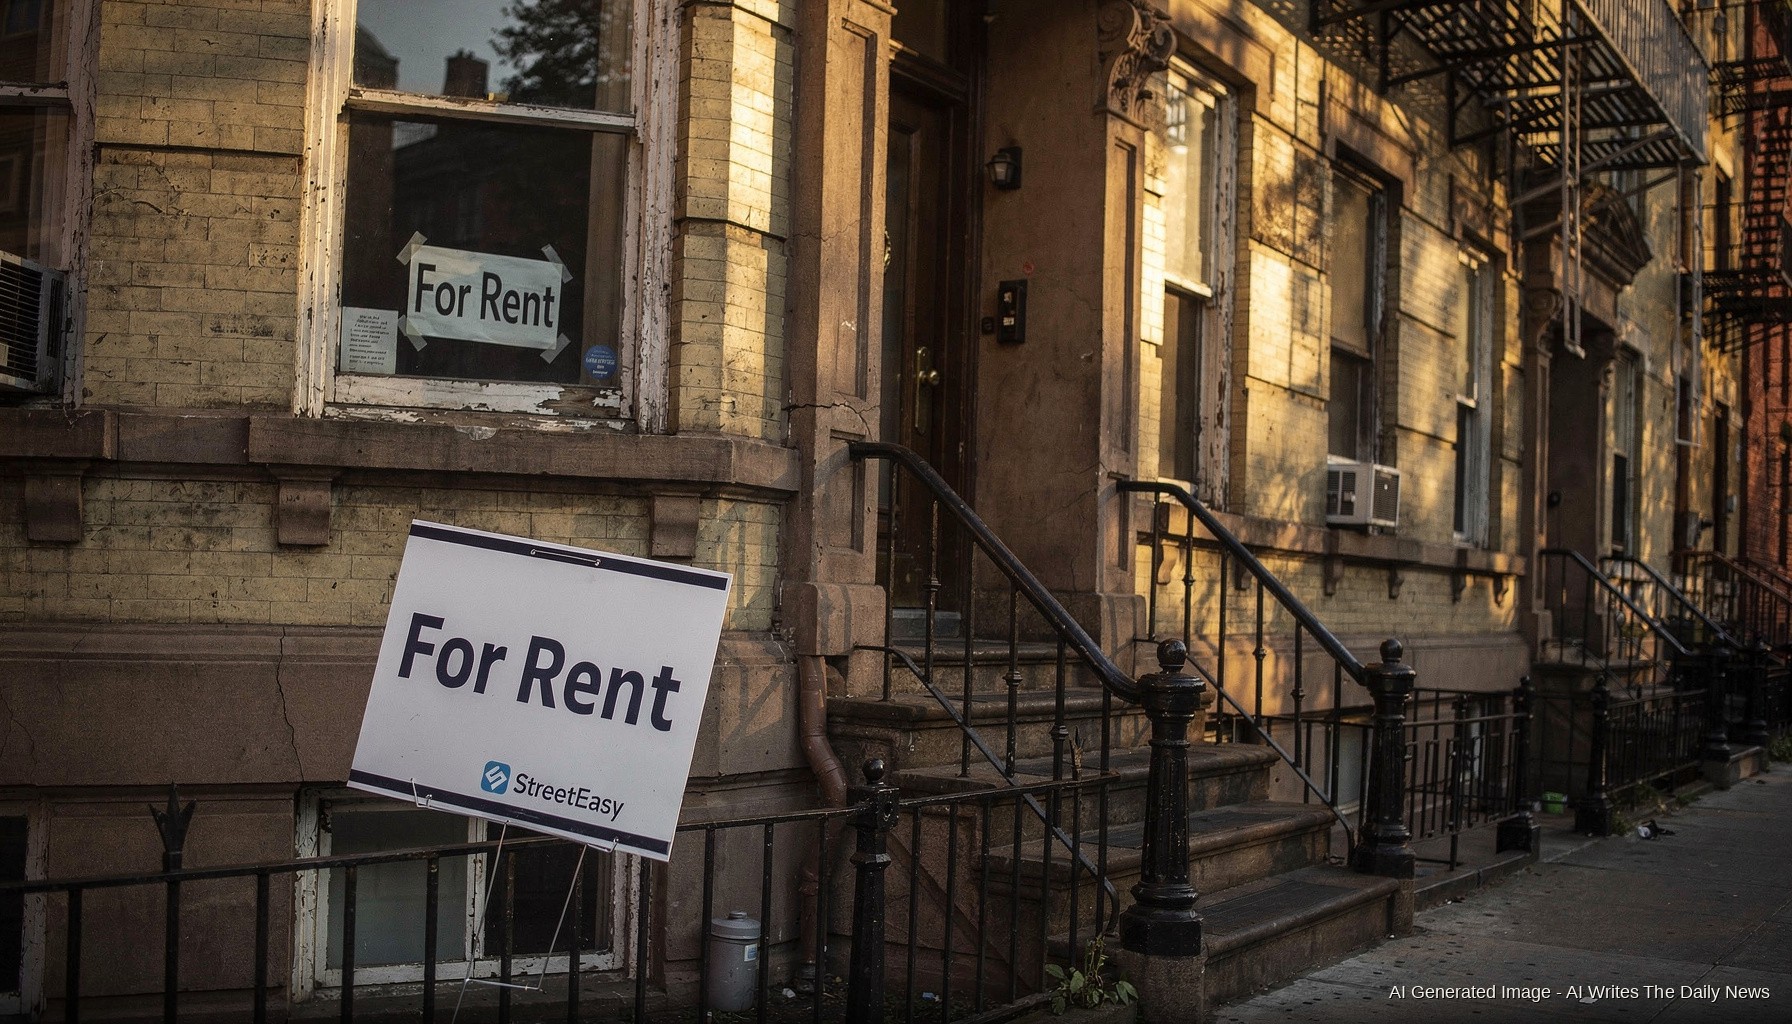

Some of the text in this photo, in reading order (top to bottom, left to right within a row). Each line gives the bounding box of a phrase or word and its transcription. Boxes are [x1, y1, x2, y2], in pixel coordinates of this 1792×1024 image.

[415, 263, 555, 328] For Rent
[398, 612, 681, 731] For Rent
[513, 773, 624, 821] StreetEasy
